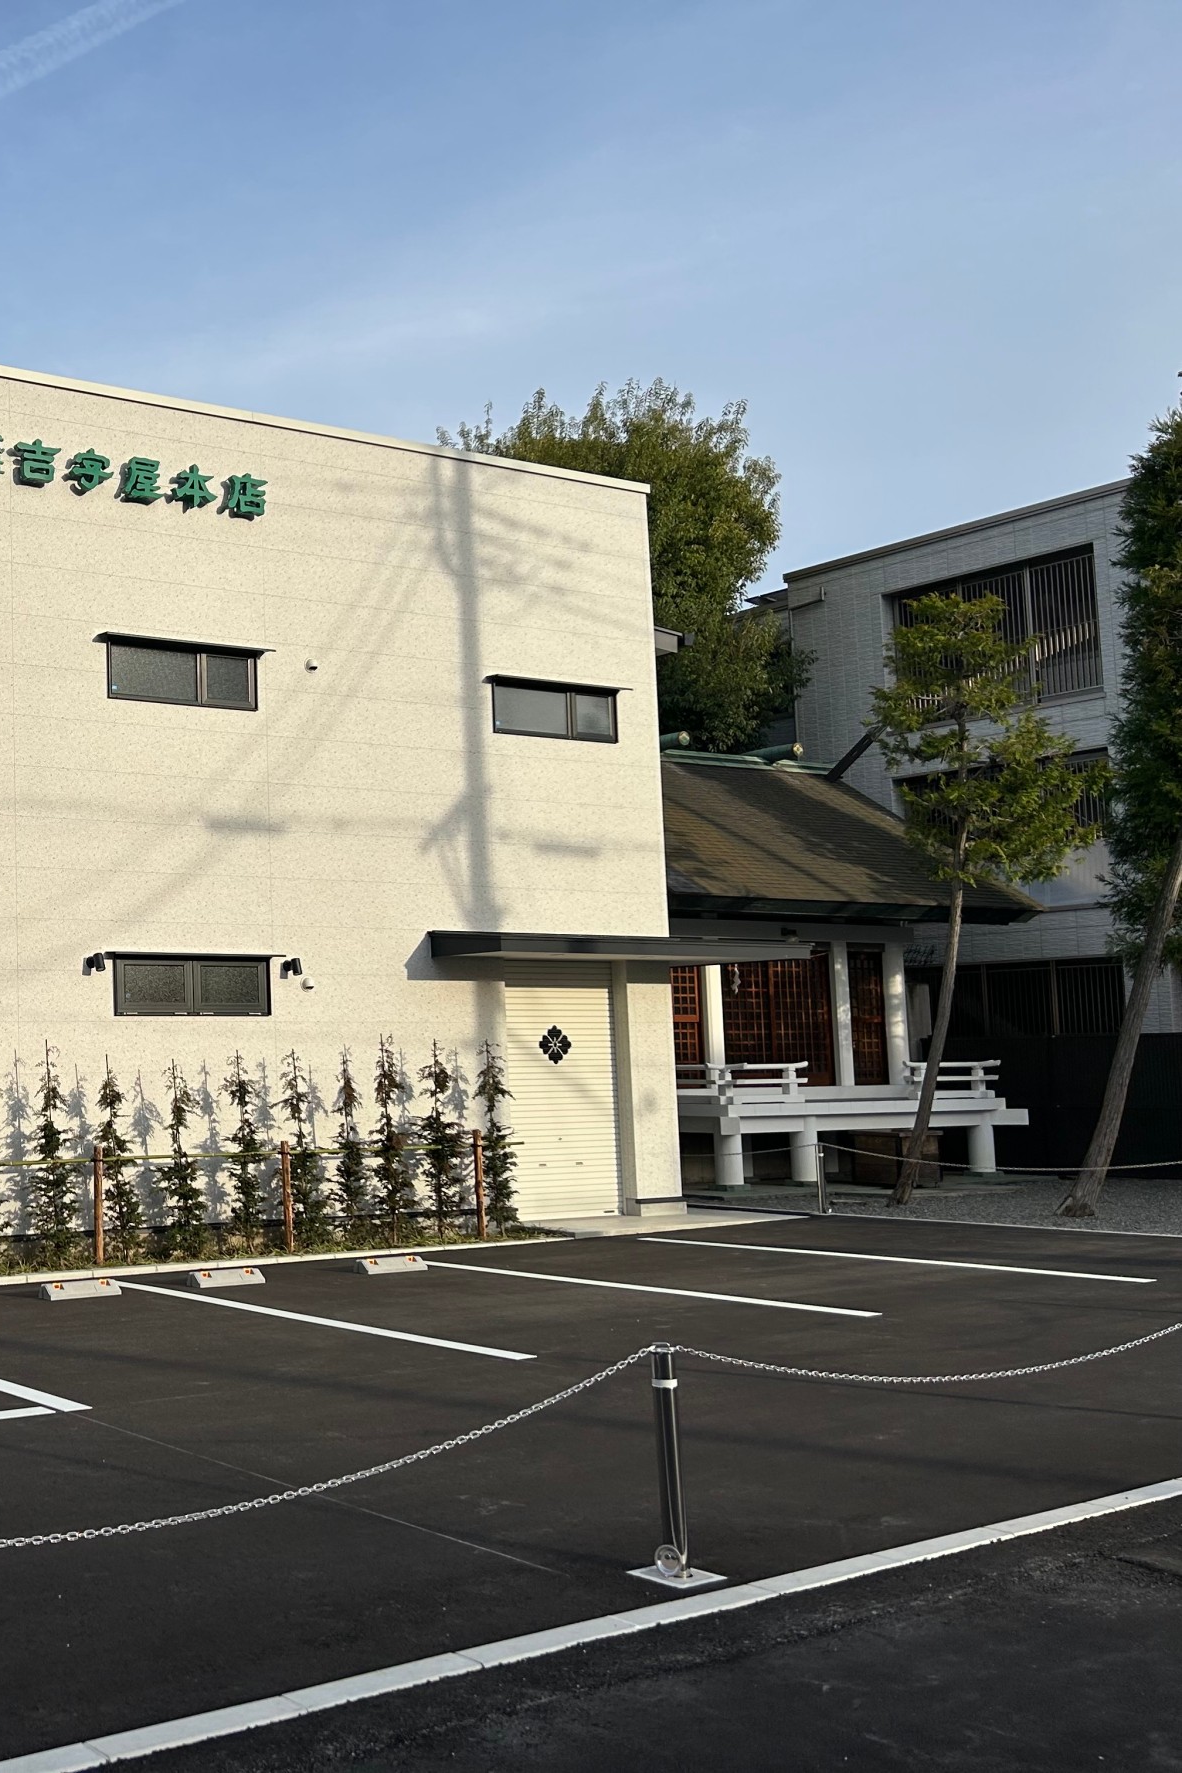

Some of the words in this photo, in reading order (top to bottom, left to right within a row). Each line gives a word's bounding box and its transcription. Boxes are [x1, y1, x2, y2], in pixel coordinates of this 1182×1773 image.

[12, 438, 269, 518] 吉字屋本店
